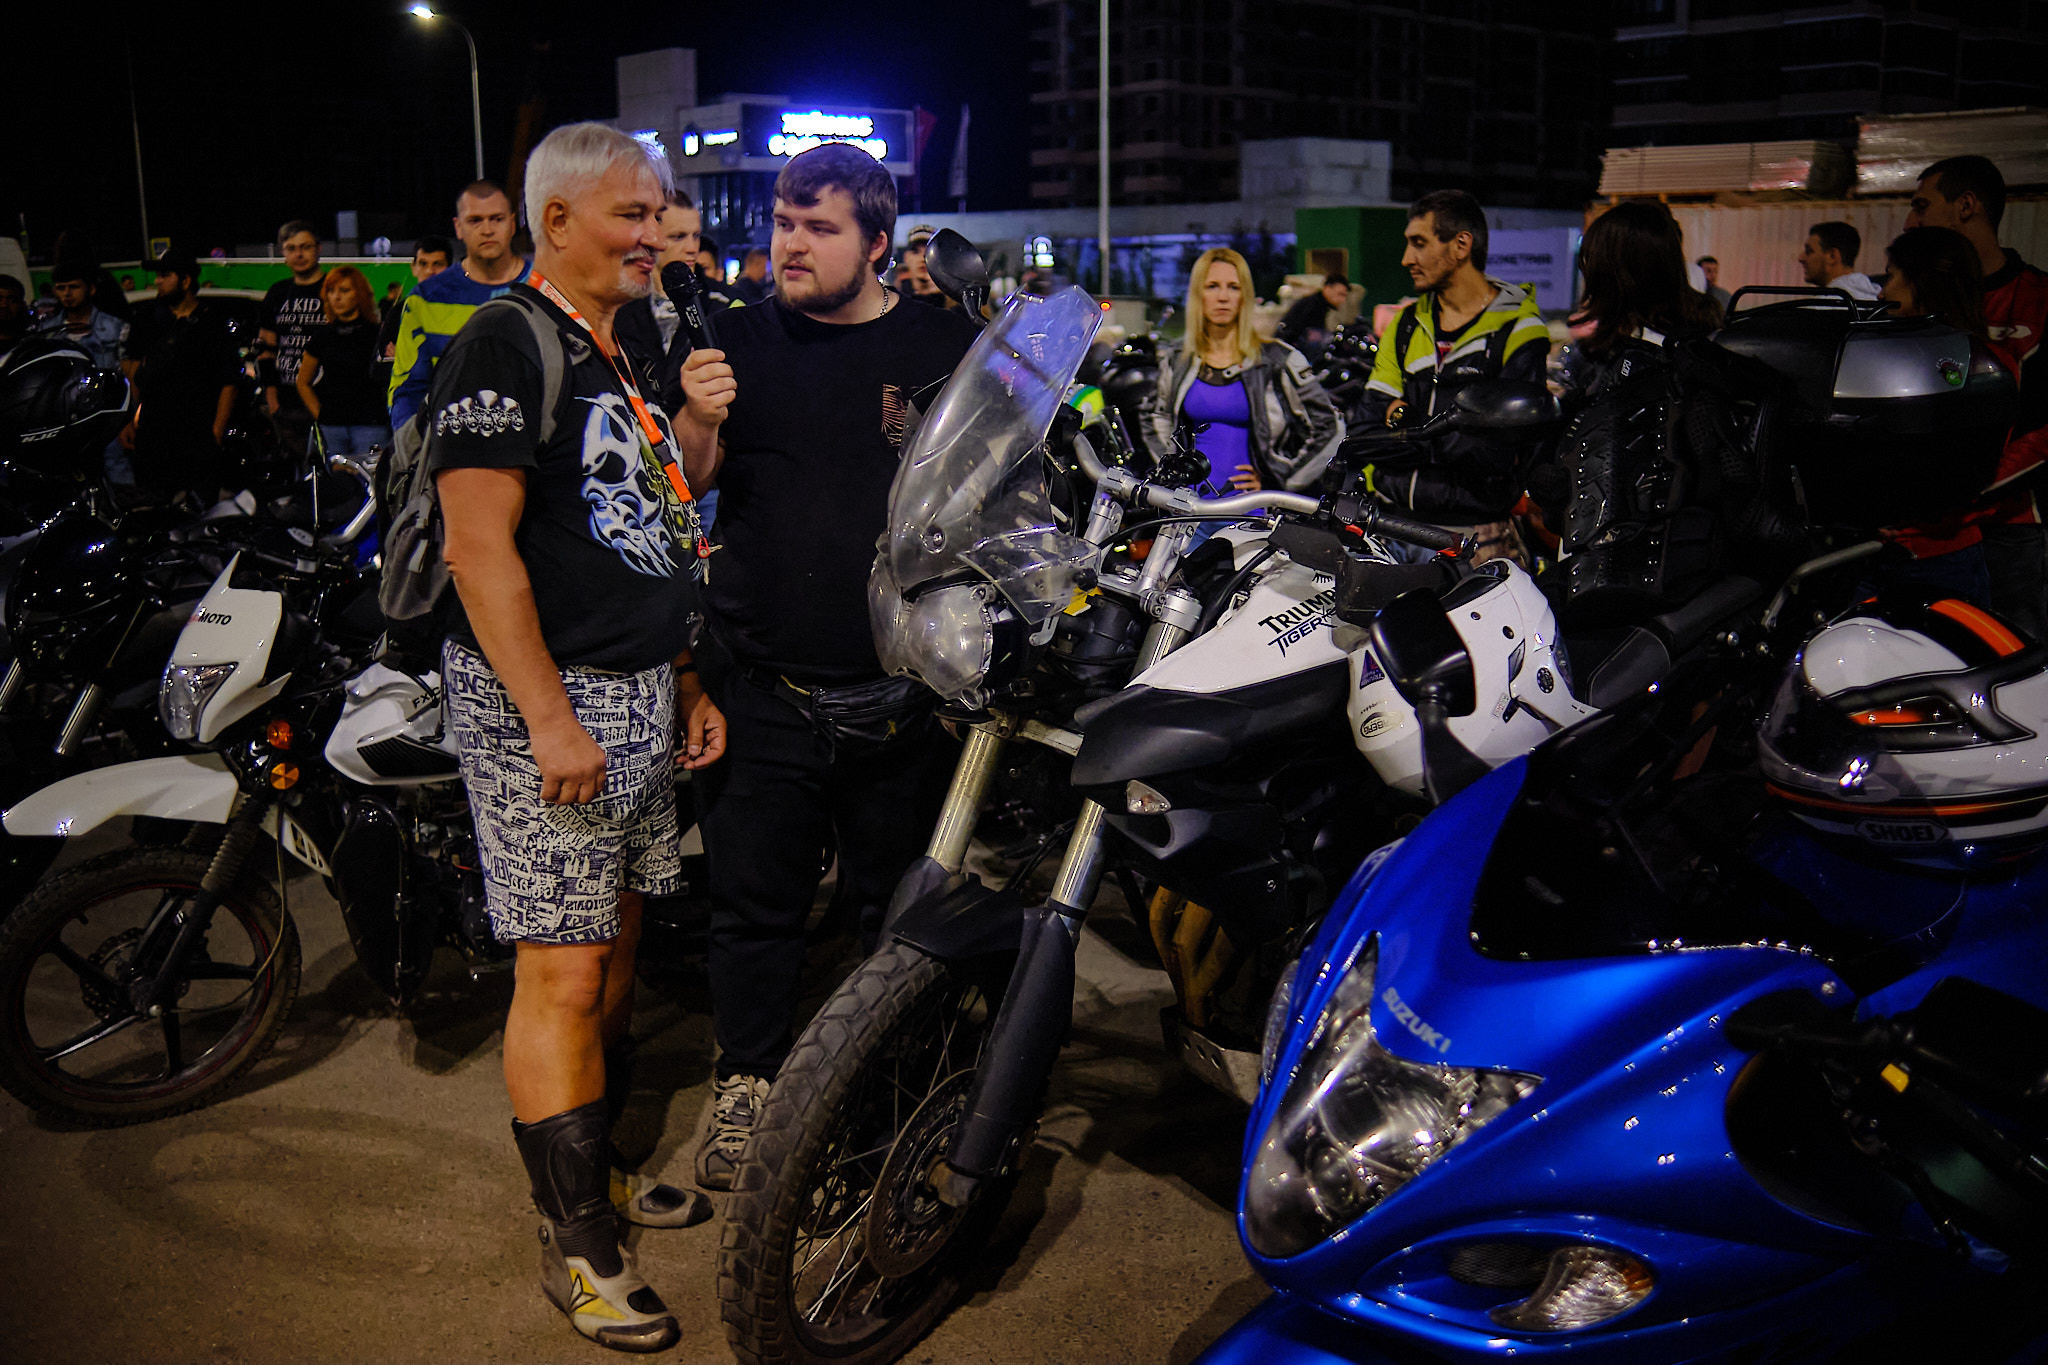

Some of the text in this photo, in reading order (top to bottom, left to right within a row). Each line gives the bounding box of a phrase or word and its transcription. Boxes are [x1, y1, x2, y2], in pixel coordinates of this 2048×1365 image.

[280, 298, 321, 313] A KID
[298, 313, 330, 325] TELLS
[1257, 586, 1337, 635] TRIUMP
[1865, 823, 1935, 841] SHOEI
[1381, 986, 1452, 1054] SUZUKI
